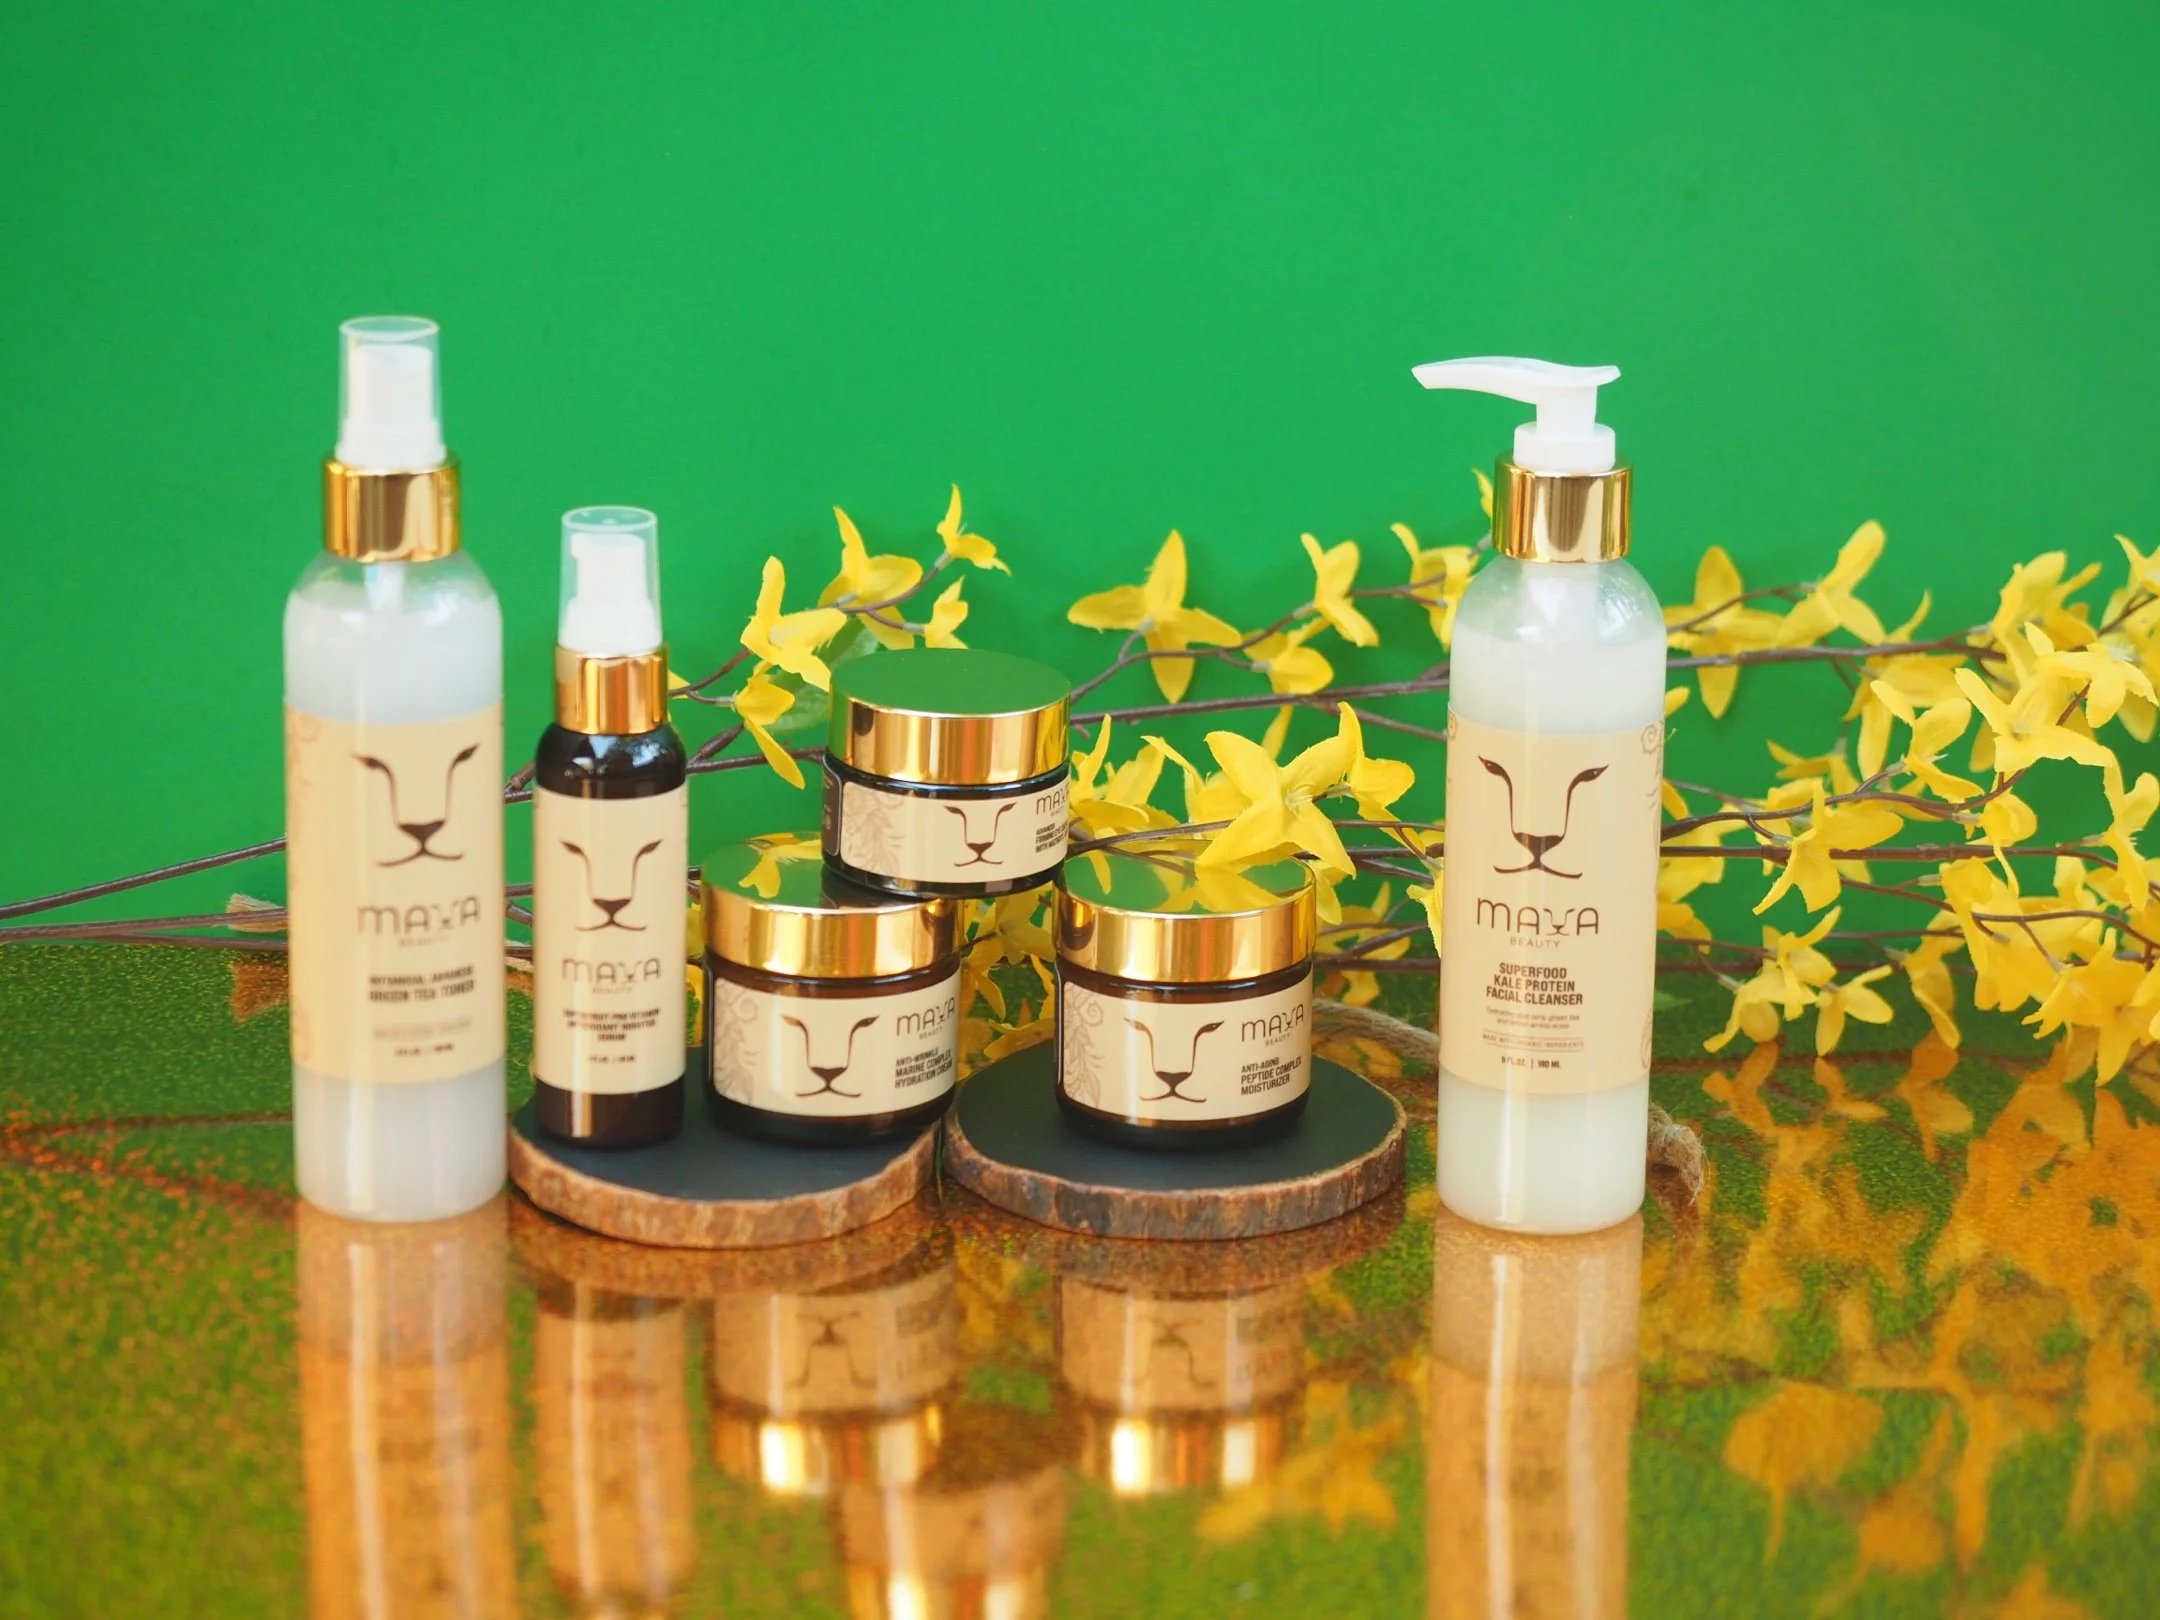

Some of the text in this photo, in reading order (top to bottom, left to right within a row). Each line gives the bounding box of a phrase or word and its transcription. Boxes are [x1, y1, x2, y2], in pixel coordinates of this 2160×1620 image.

[1477, 897, 1599, 936] MAYA
[1510, 936, 1560, 949] BEAUTY
[562, 957, 661, 984] MAYA
[1499, 963, 1567, 979] SUPERFOOD
[1493, 975, 1575, 992] KALE PROTEIN
[1486, 986, 1583, 1005] FACIAL CLEANSER
[896, 997, 955, 1037] MAYA
[1241, 1003, 1304, 1042] MAYA
[1265, 1033, 1290, 1047] BEAUTY
[895, 1061, 925, 1077] MARINE
[1241, 1057, 1280, 1073] ANTI-AGING
[894, 1069, 935, 1088] HYDRATION
[1241, 1069, 1274, 1085] PEPTIDE
[1241, 1073, 1290, 1096] MOISTURIZER
